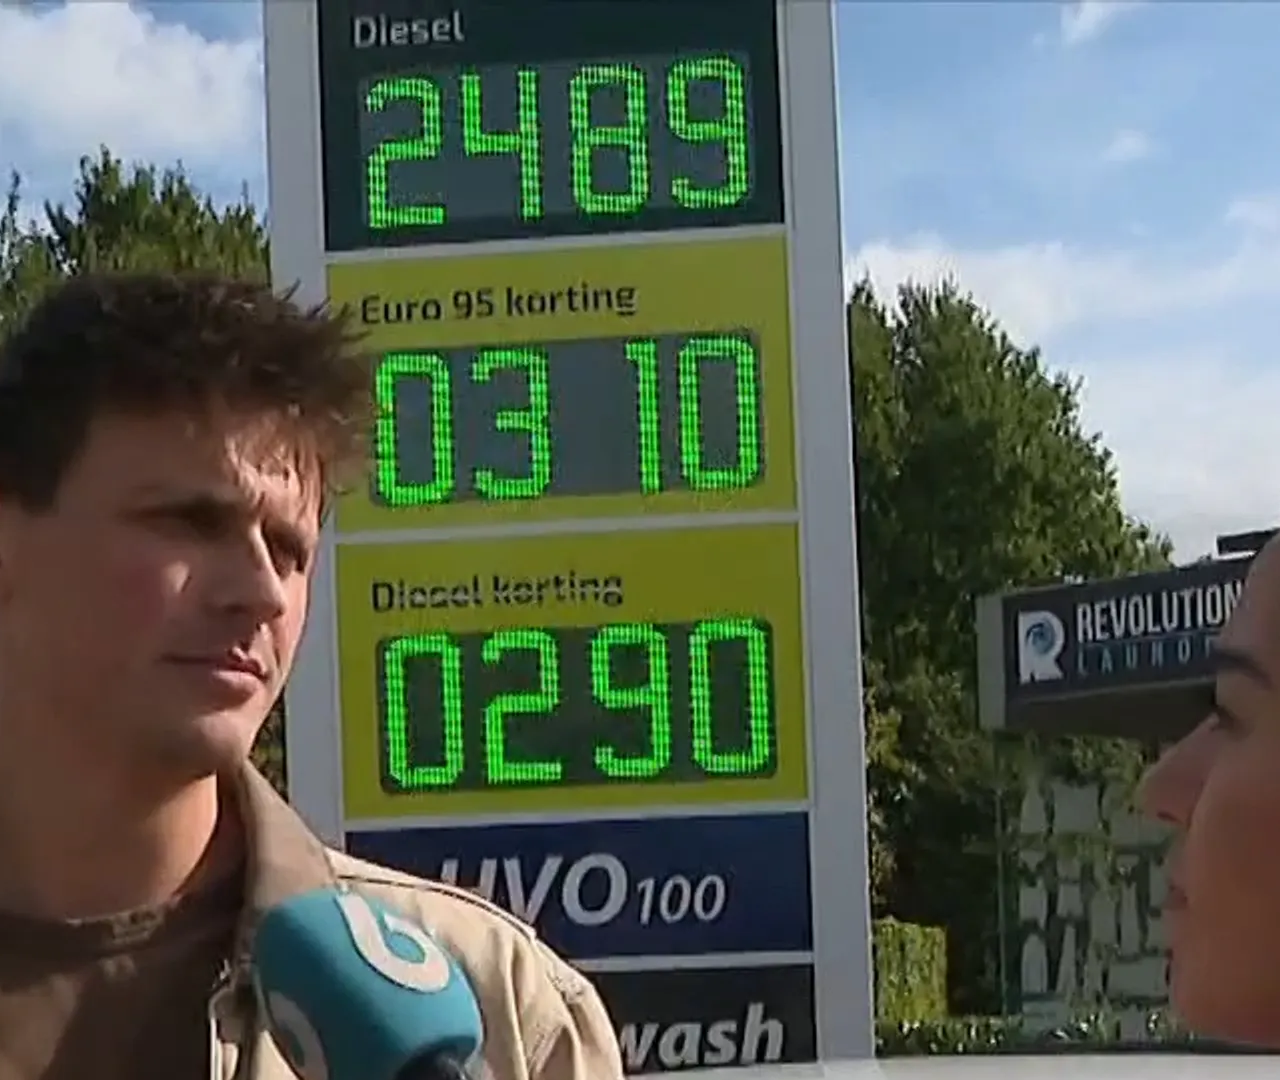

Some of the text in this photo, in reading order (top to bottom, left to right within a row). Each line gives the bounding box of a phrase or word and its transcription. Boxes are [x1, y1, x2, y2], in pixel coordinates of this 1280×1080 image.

[354, 9, 466, 48] Diesel
[365, 57, 749, 229] 2489
[361, 281, 637, 324] Euro 95 korting
[371, 570, 625, 613] Diesel korting
[383, 618, 772, 788] 0290
